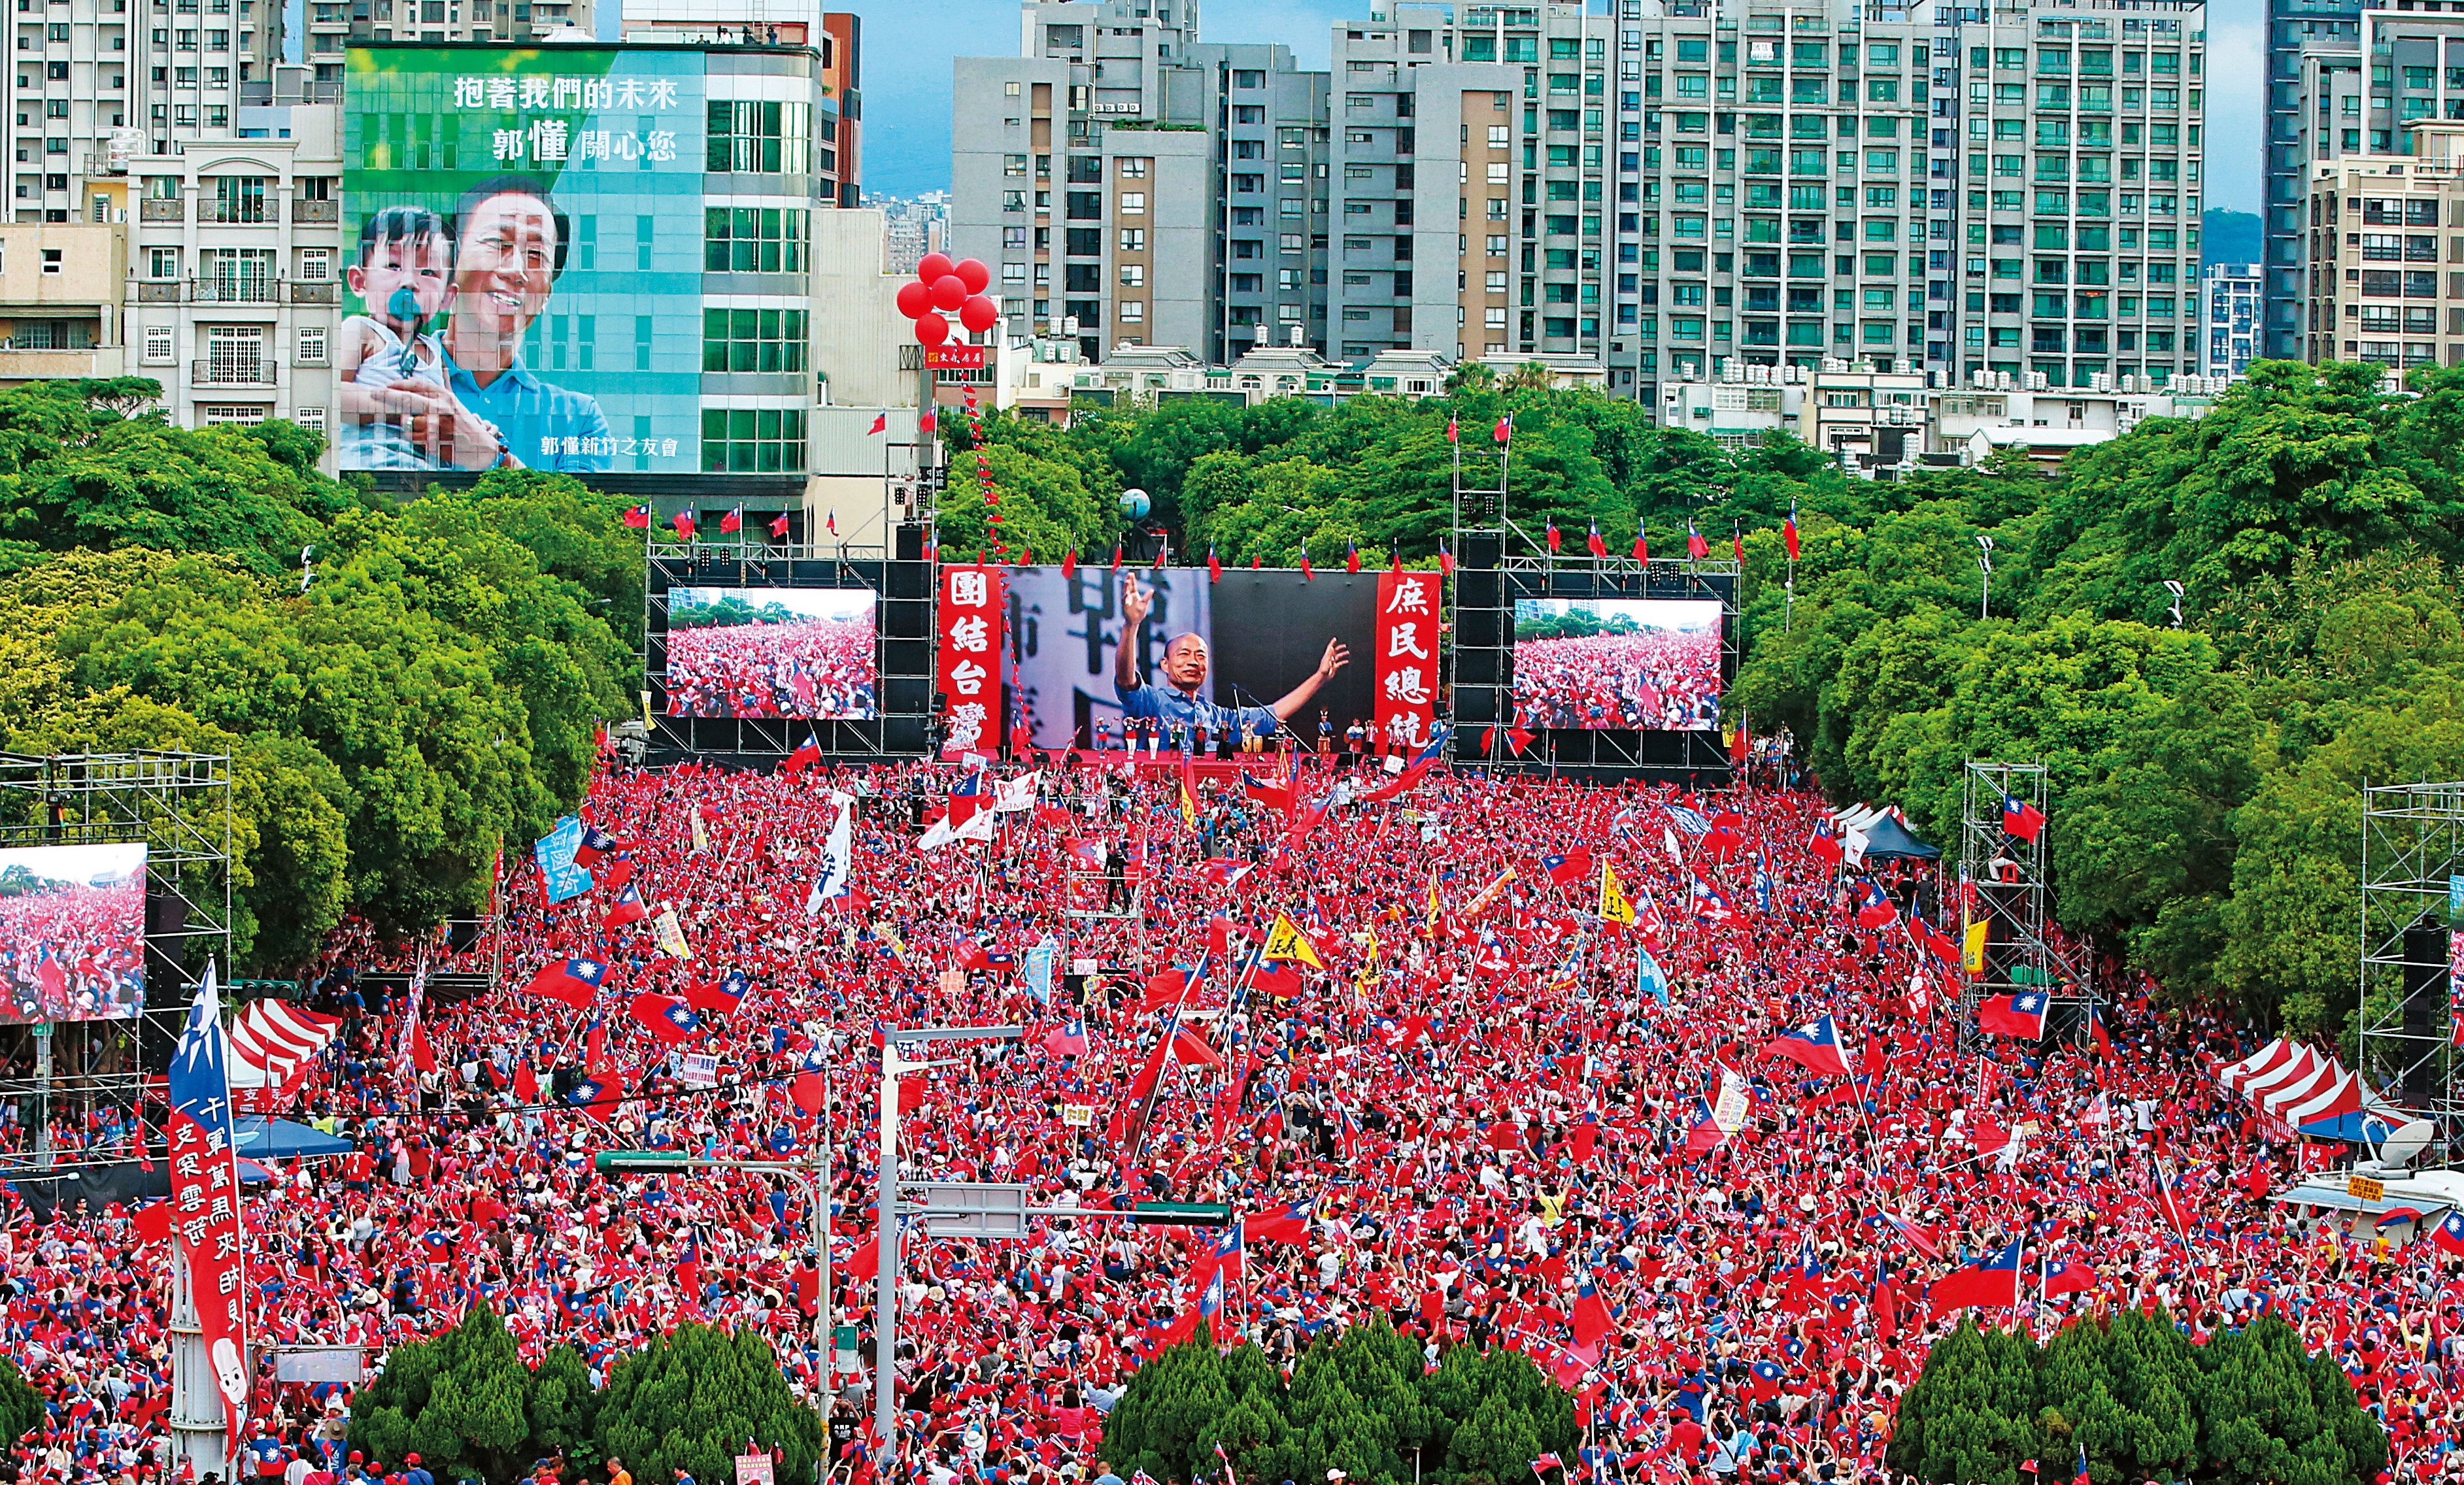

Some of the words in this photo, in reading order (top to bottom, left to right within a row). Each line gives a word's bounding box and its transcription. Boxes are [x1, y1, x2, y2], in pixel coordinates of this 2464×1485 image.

[454, 77, 678, 110] 抱著我們的未來
[492, 120, 569, 161] 郭懂
[581, 129, 677, 161] 關心您
[541, 436, 678, 458] 郭懂新竹之友會
[950, 571, 988, 741] 團結台灣
[1385, 577, 1431, 749] 庶民總統
[172, 1097, 209, 1247] 一支穿雲箭
[198, 1096, 243, 1332] 千軍萬馬來相見
